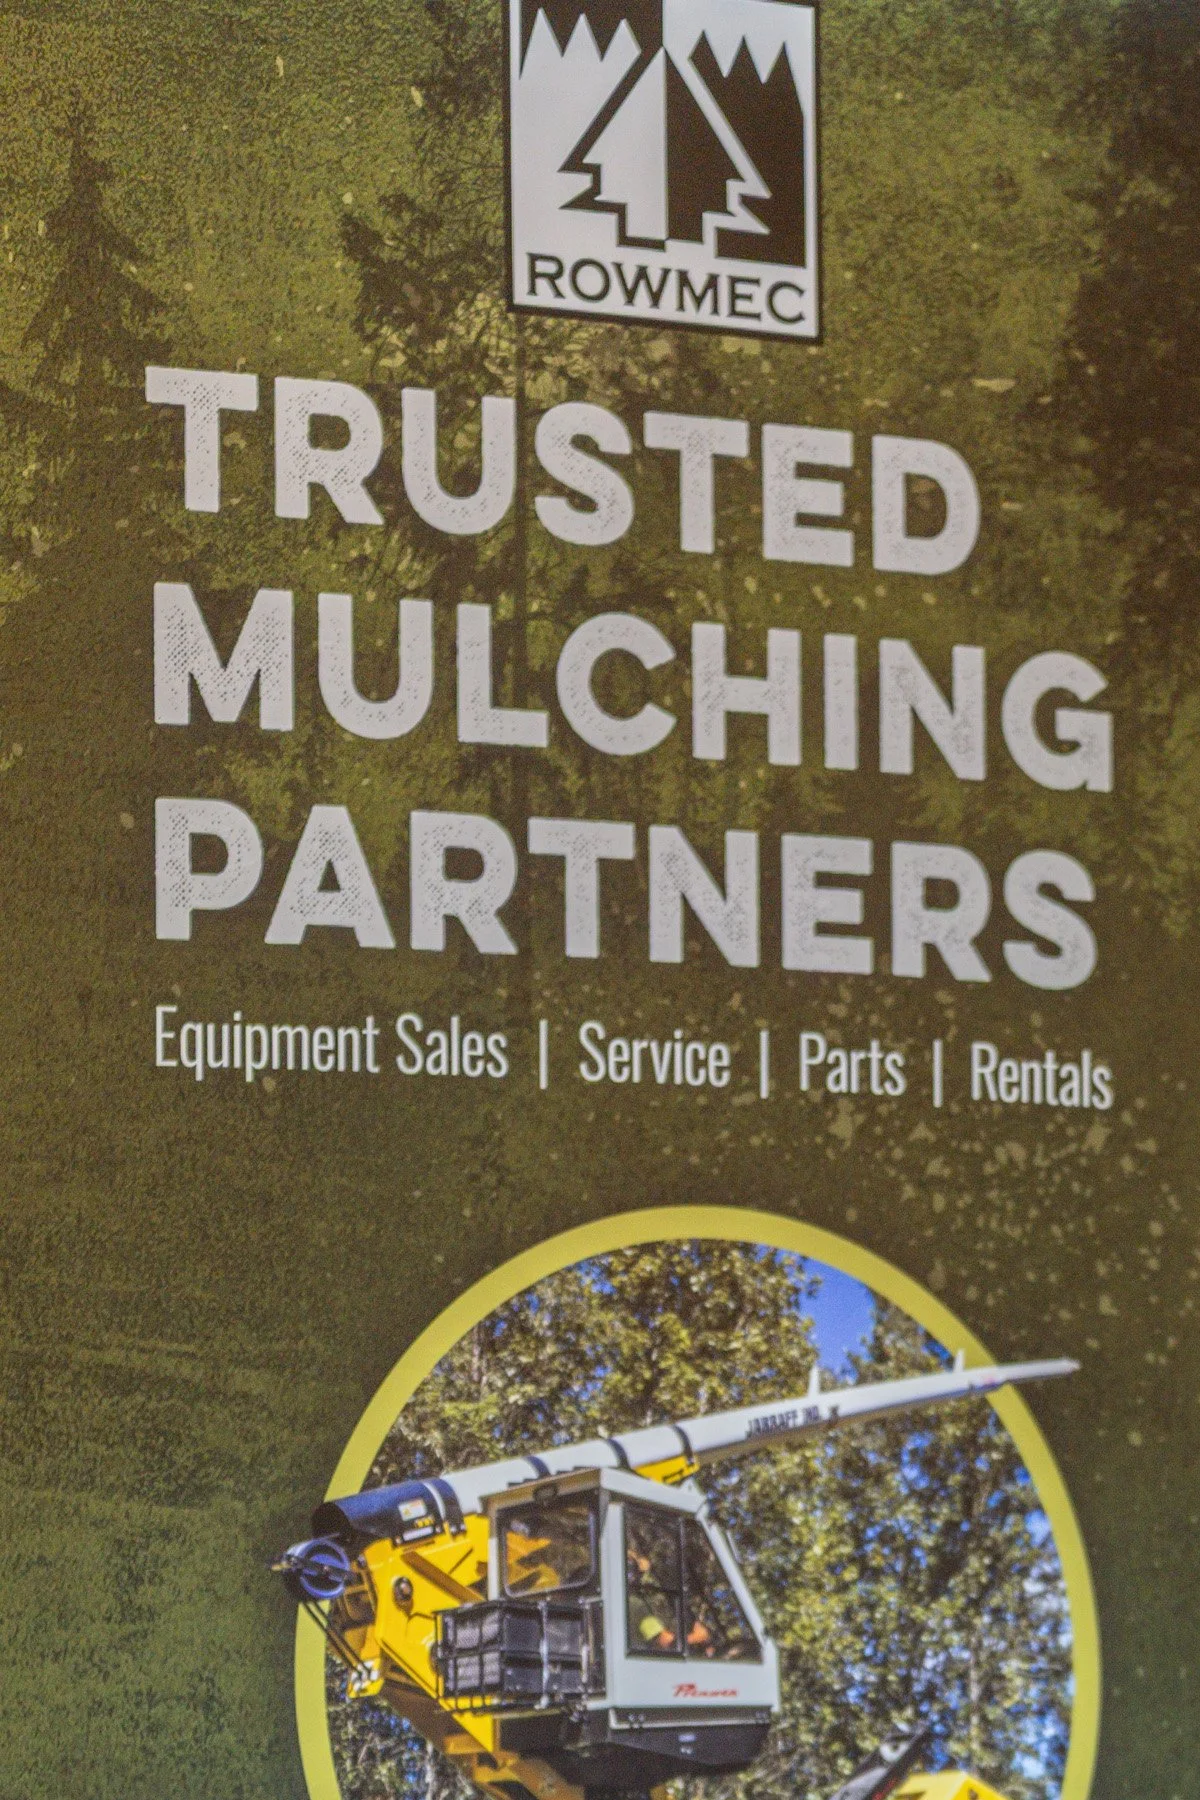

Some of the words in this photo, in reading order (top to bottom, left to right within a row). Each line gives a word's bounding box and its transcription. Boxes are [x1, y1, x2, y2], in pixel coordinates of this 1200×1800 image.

[526, 252, 805, 324] ROWMEC
[144, 366, 983, 576] TRUSTED
[153, 582, 1115, 793] MULCHING
[153, 797, 1098, 991] PARTNERS
[154, 1006, 380, 1083] Equipment
[396, 1012, 509, 1079] Sales
[578, 1020, 731, 1088] Service
[799, 1031, 907, 1097] Parts
[970, 1041, 1113, 1110] Rentals
